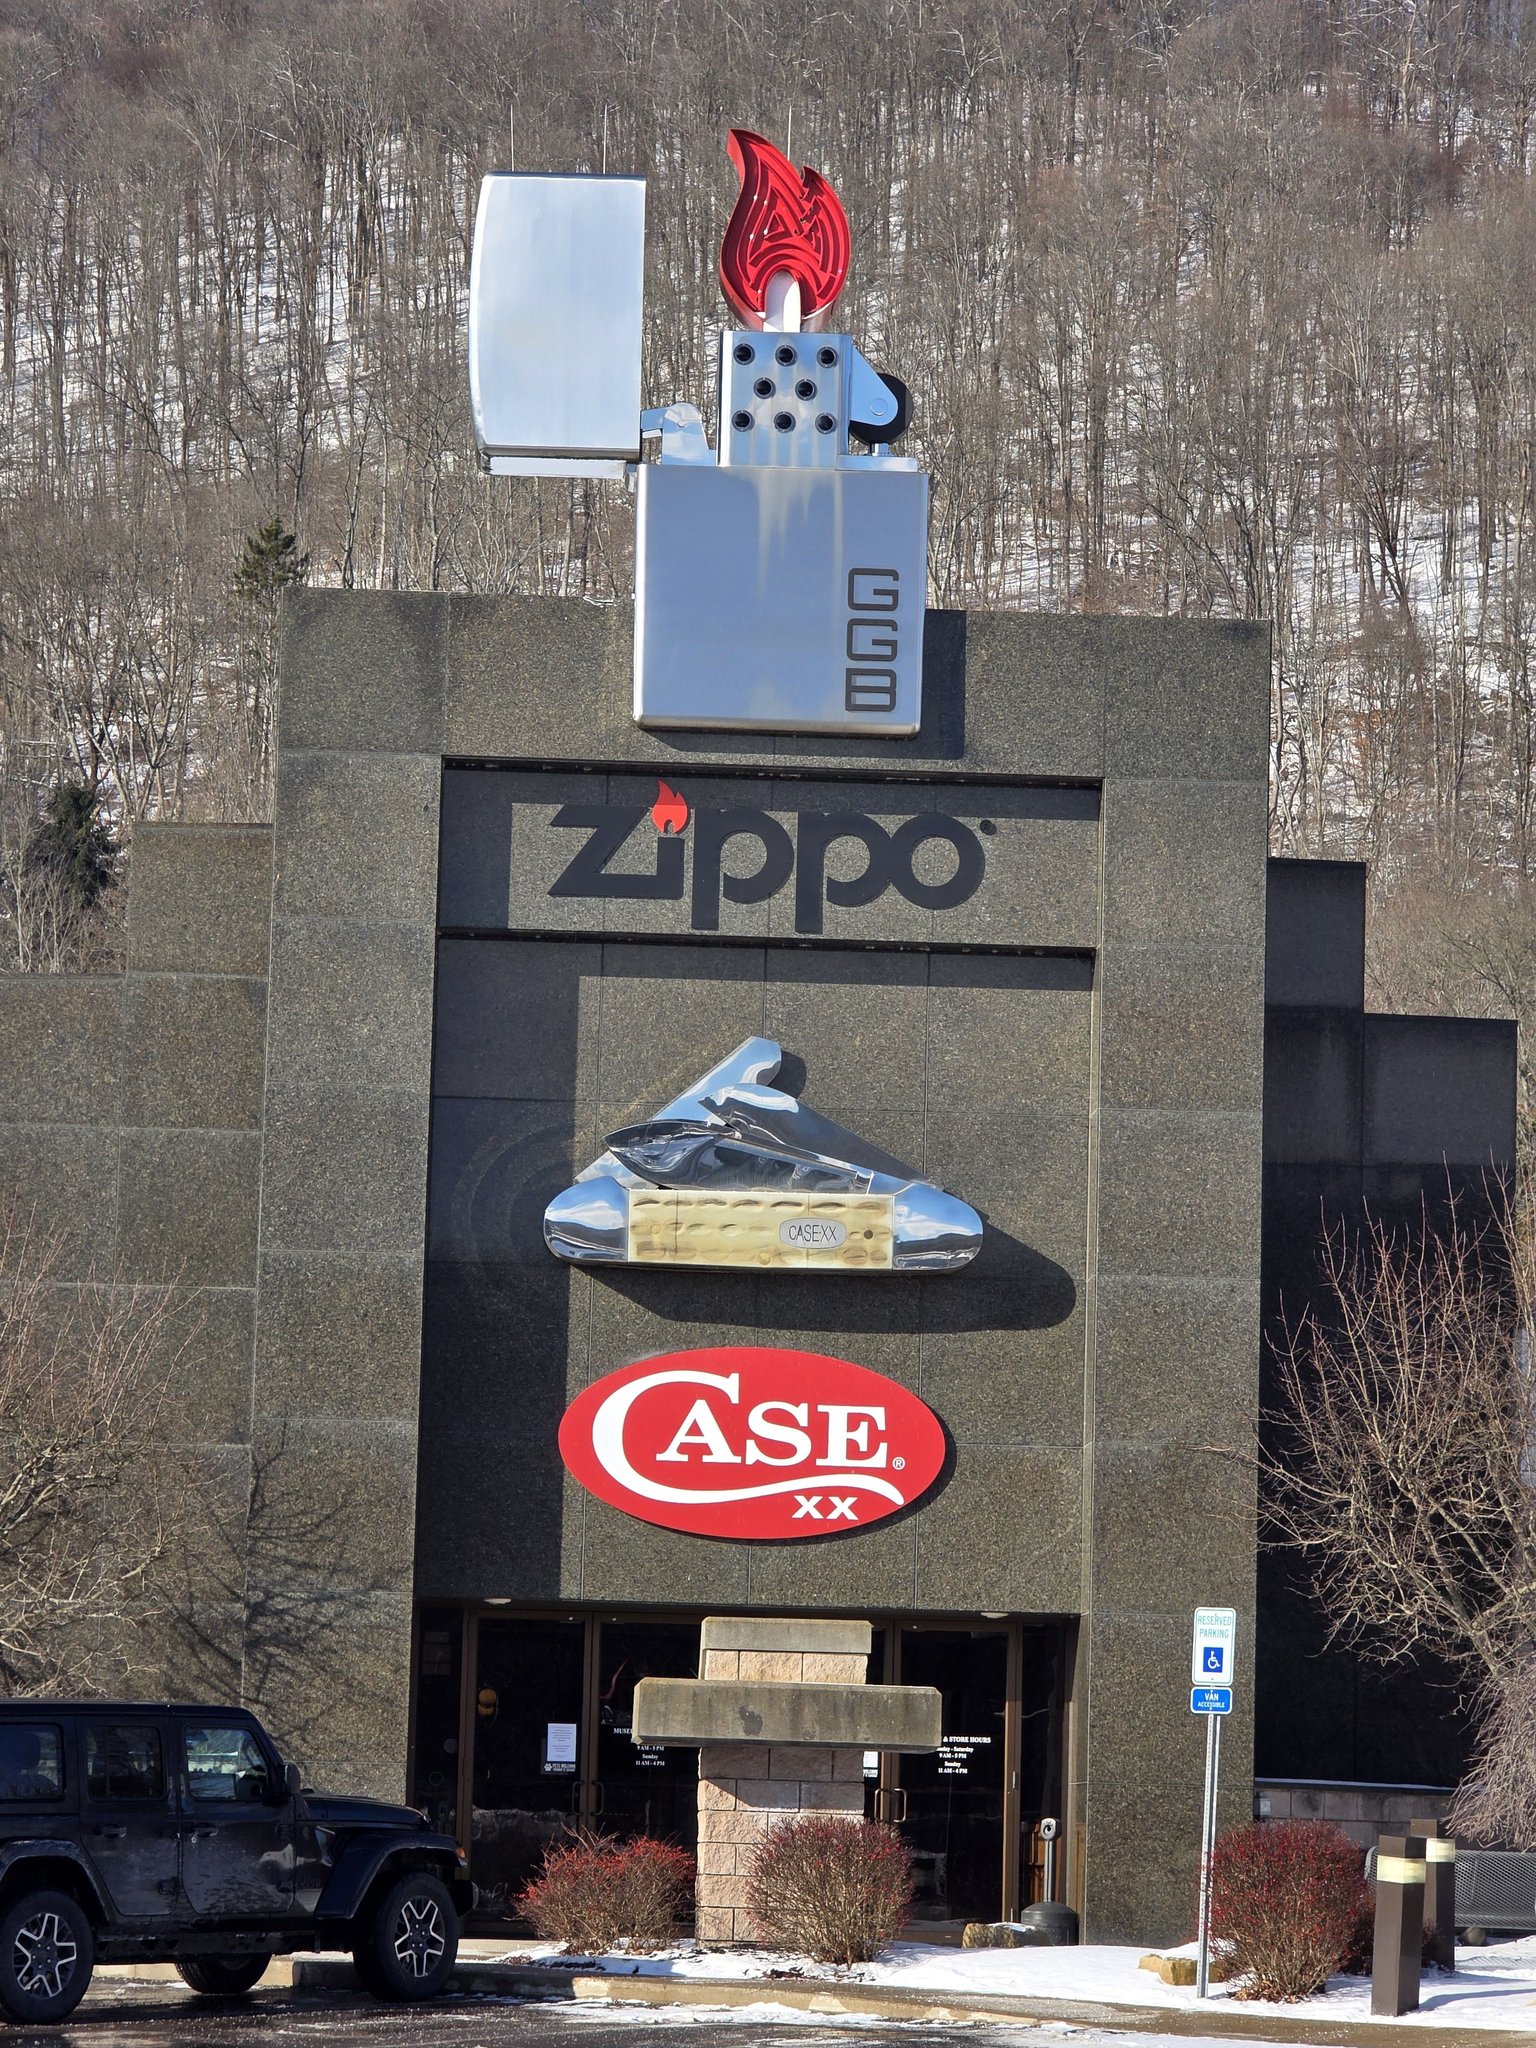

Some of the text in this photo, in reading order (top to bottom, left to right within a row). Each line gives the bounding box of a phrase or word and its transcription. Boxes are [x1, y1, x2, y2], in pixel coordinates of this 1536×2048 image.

[845, 567, 900, 713] GGB
[791, 1495, 859, 1520] XX
[1197, 1615, 1232, 1626] RESERVED
[1199, 1628, 1229, 1639] PARKING
[1204, 1693, 1219, 1701] VAN
